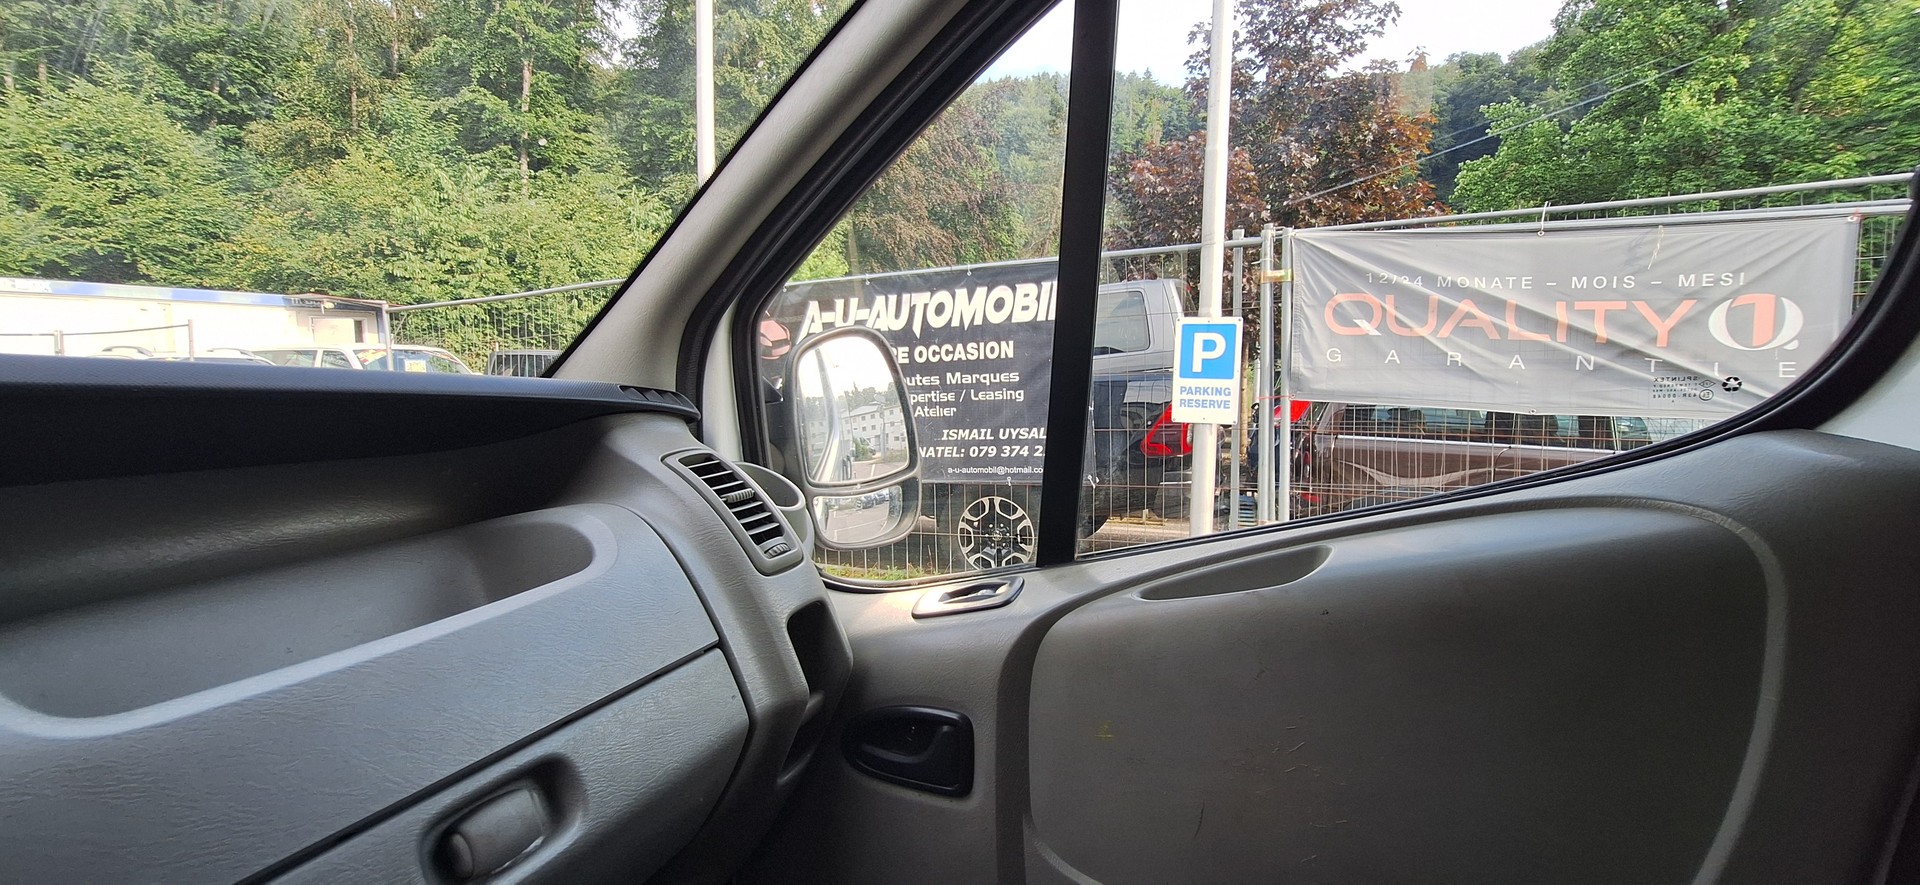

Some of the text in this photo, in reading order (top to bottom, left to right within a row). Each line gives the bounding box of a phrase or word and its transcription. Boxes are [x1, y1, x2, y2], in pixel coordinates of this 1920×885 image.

[1437, 276, 1533, 289] MONATE
[1571, 275, 1636, 289] MOIS
[1678, 272, 1745, 287] MESI
[1324, 293, 1698, 348] QUALITY
[914, 340, 1014, 364] OCCASION
[1192, 332, 1226, 373] P
[1326, 347, 1797, 378] GARANTIE
[904, 371, 1020, 386] utes Marques
[909, 390, 956, 405] pertise
[970, 388, 1024, 402] Leasing
[1179, 386, 1232, 397] PARKING
[914, 405, 957, 418] Atelier
[1179, 399, 1231, 410] RESERVE
[941, 427, 1047, 440] ISMAIL UYSAL
[969, 445, 997, 457] 079
[1000, 445, 1029, 457] 374
[1033, 445, 1046, 457] 2
[947, 465, 1044, 476] a-u-automobil@hotmail.co
